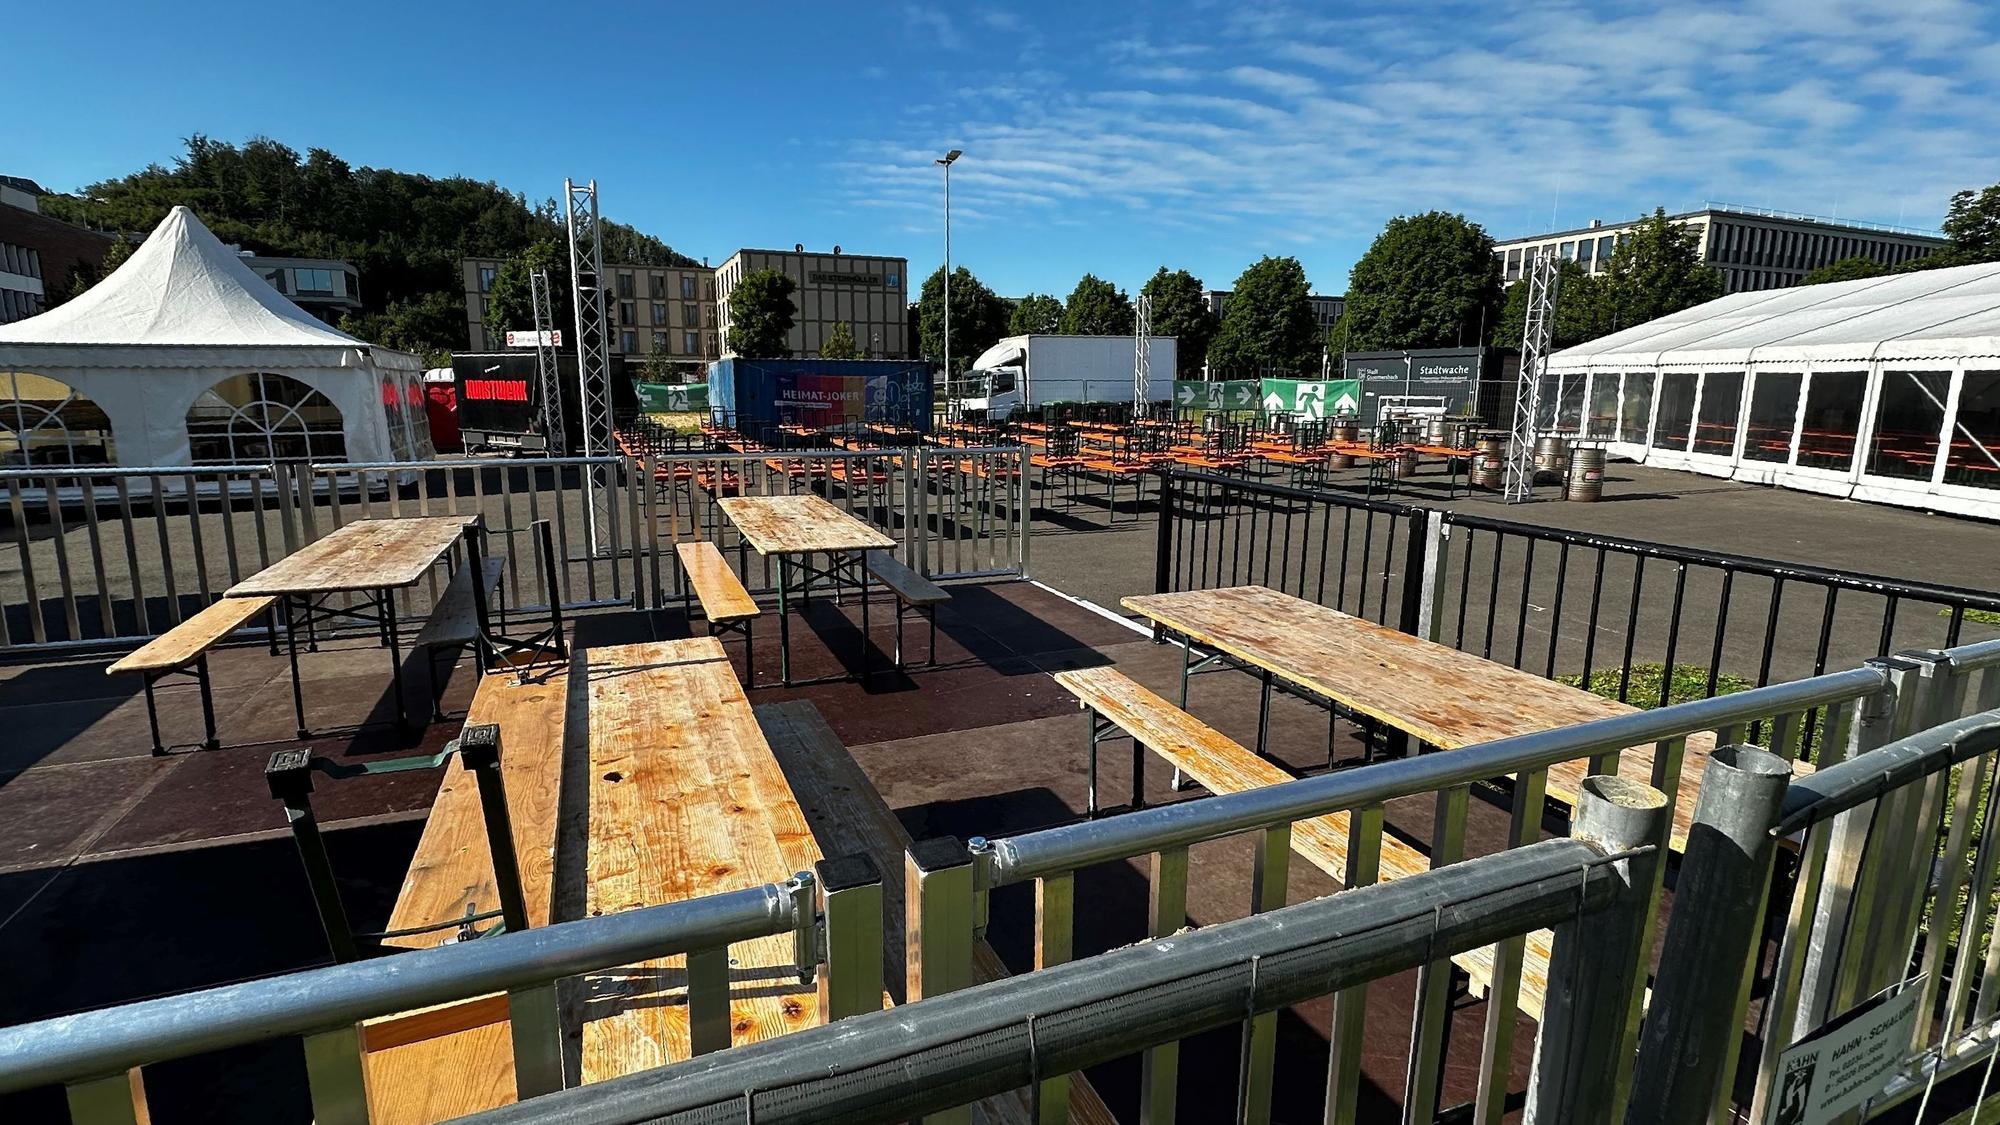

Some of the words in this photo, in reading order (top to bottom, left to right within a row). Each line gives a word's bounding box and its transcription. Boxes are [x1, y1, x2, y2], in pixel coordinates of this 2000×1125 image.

[1420, 365, 1469, 375] Stadtwache
[782, 389, 860, 401] HEIMAT-JOKER
[1832, 1035, 1861, 1062] HAHN
